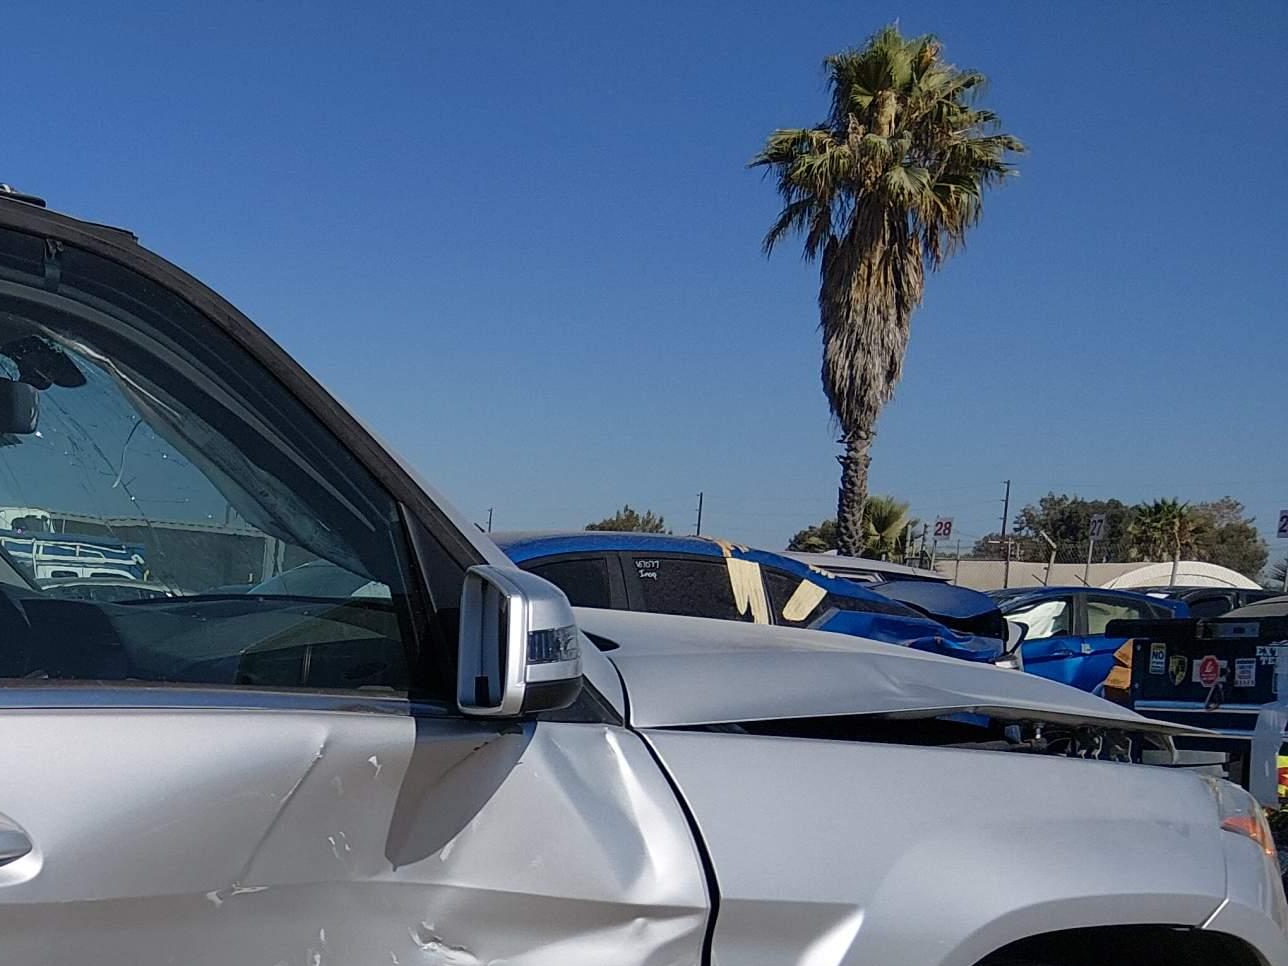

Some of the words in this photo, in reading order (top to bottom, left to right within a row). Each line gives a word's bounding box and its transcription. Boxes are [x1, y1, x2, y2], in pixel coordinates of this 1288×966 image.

[934, 521, 952, 536] 28
[1090, 519, 1104, 537] 27
[1152, 651, 1164, 660] NO
